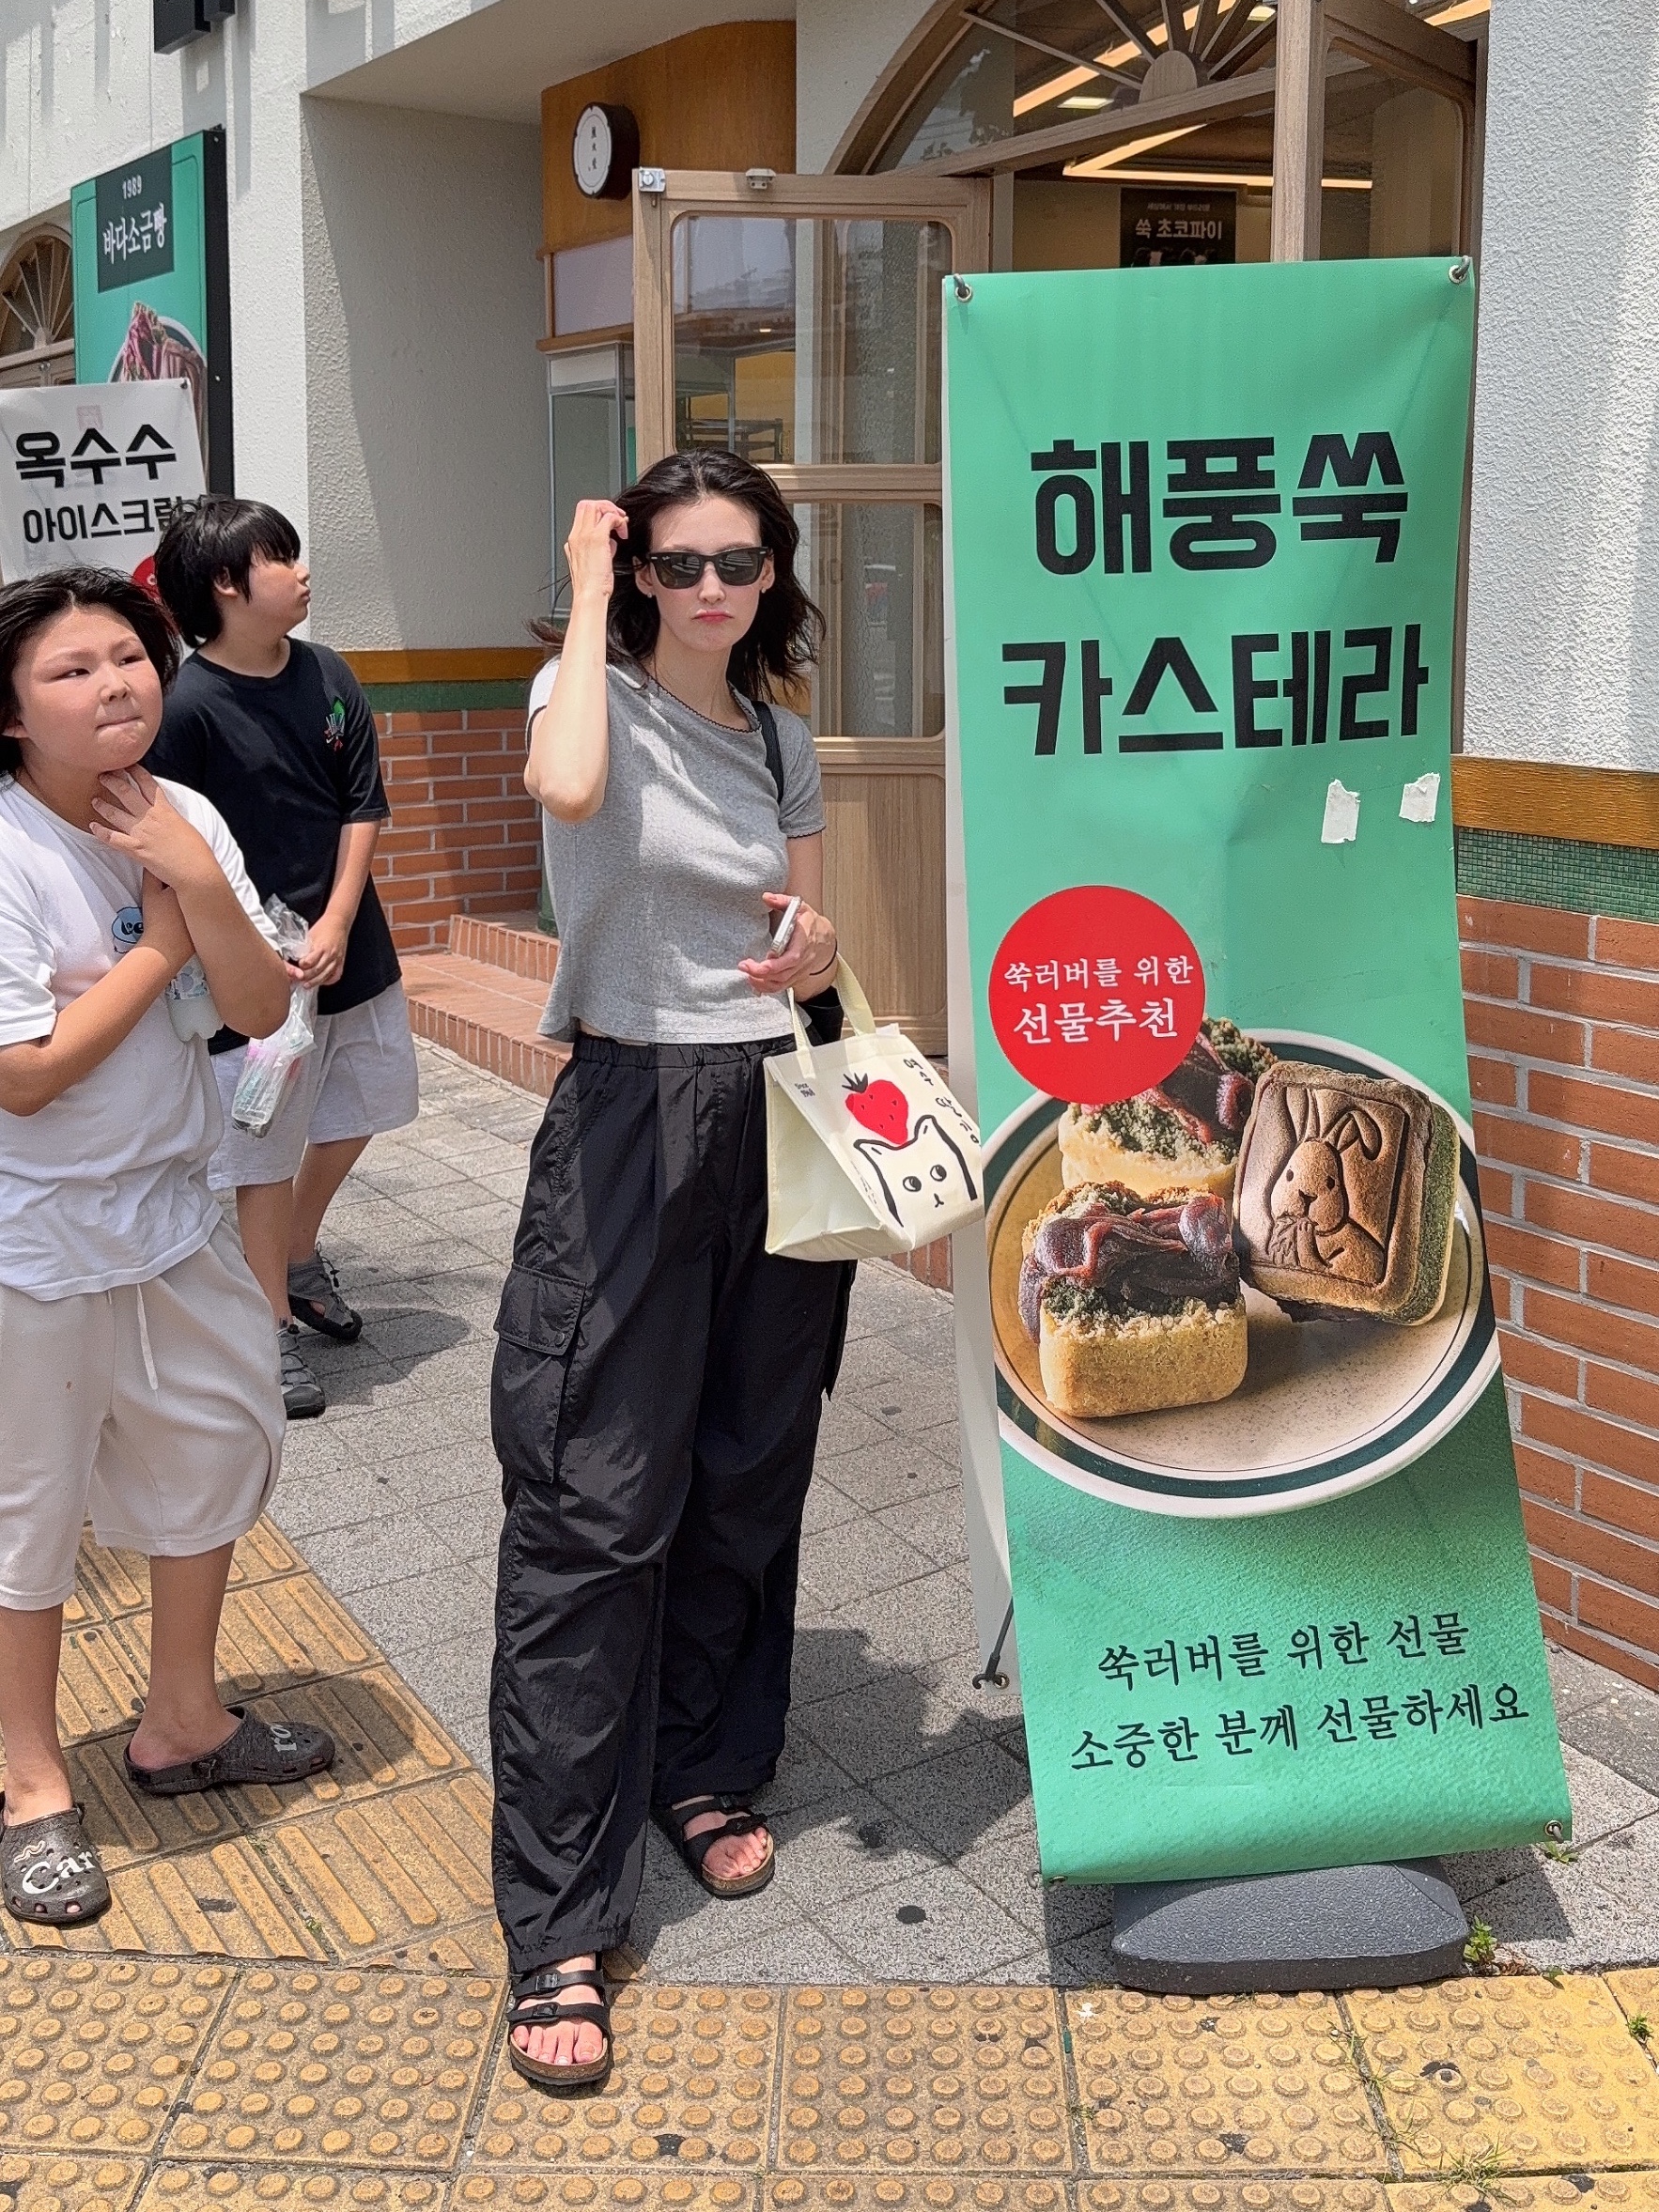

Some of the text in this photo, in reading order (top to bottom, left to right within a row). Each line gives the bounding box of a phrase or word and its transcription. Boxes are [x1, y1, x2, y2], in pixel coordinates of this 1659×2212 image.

[122, 175, 142, 199] 1989
[1135, 218, 1222, 240] 쑥 초코파이
[16, 424, 177, 488] 옥수수
[1031, 431, 1408, 575] 해풍쑥
[1001, 624, 1429, 756] 카스테라
[1003, 954, 1194, 993] 쑥러버를 위한
[1013, 997, 1178, 1044] 선물추천
[1097, 1612, 1469, 1691] 쑥러버를 위한 선물
[1070, 1682, 1530, 1771] 소중한 분께 선물하세요
